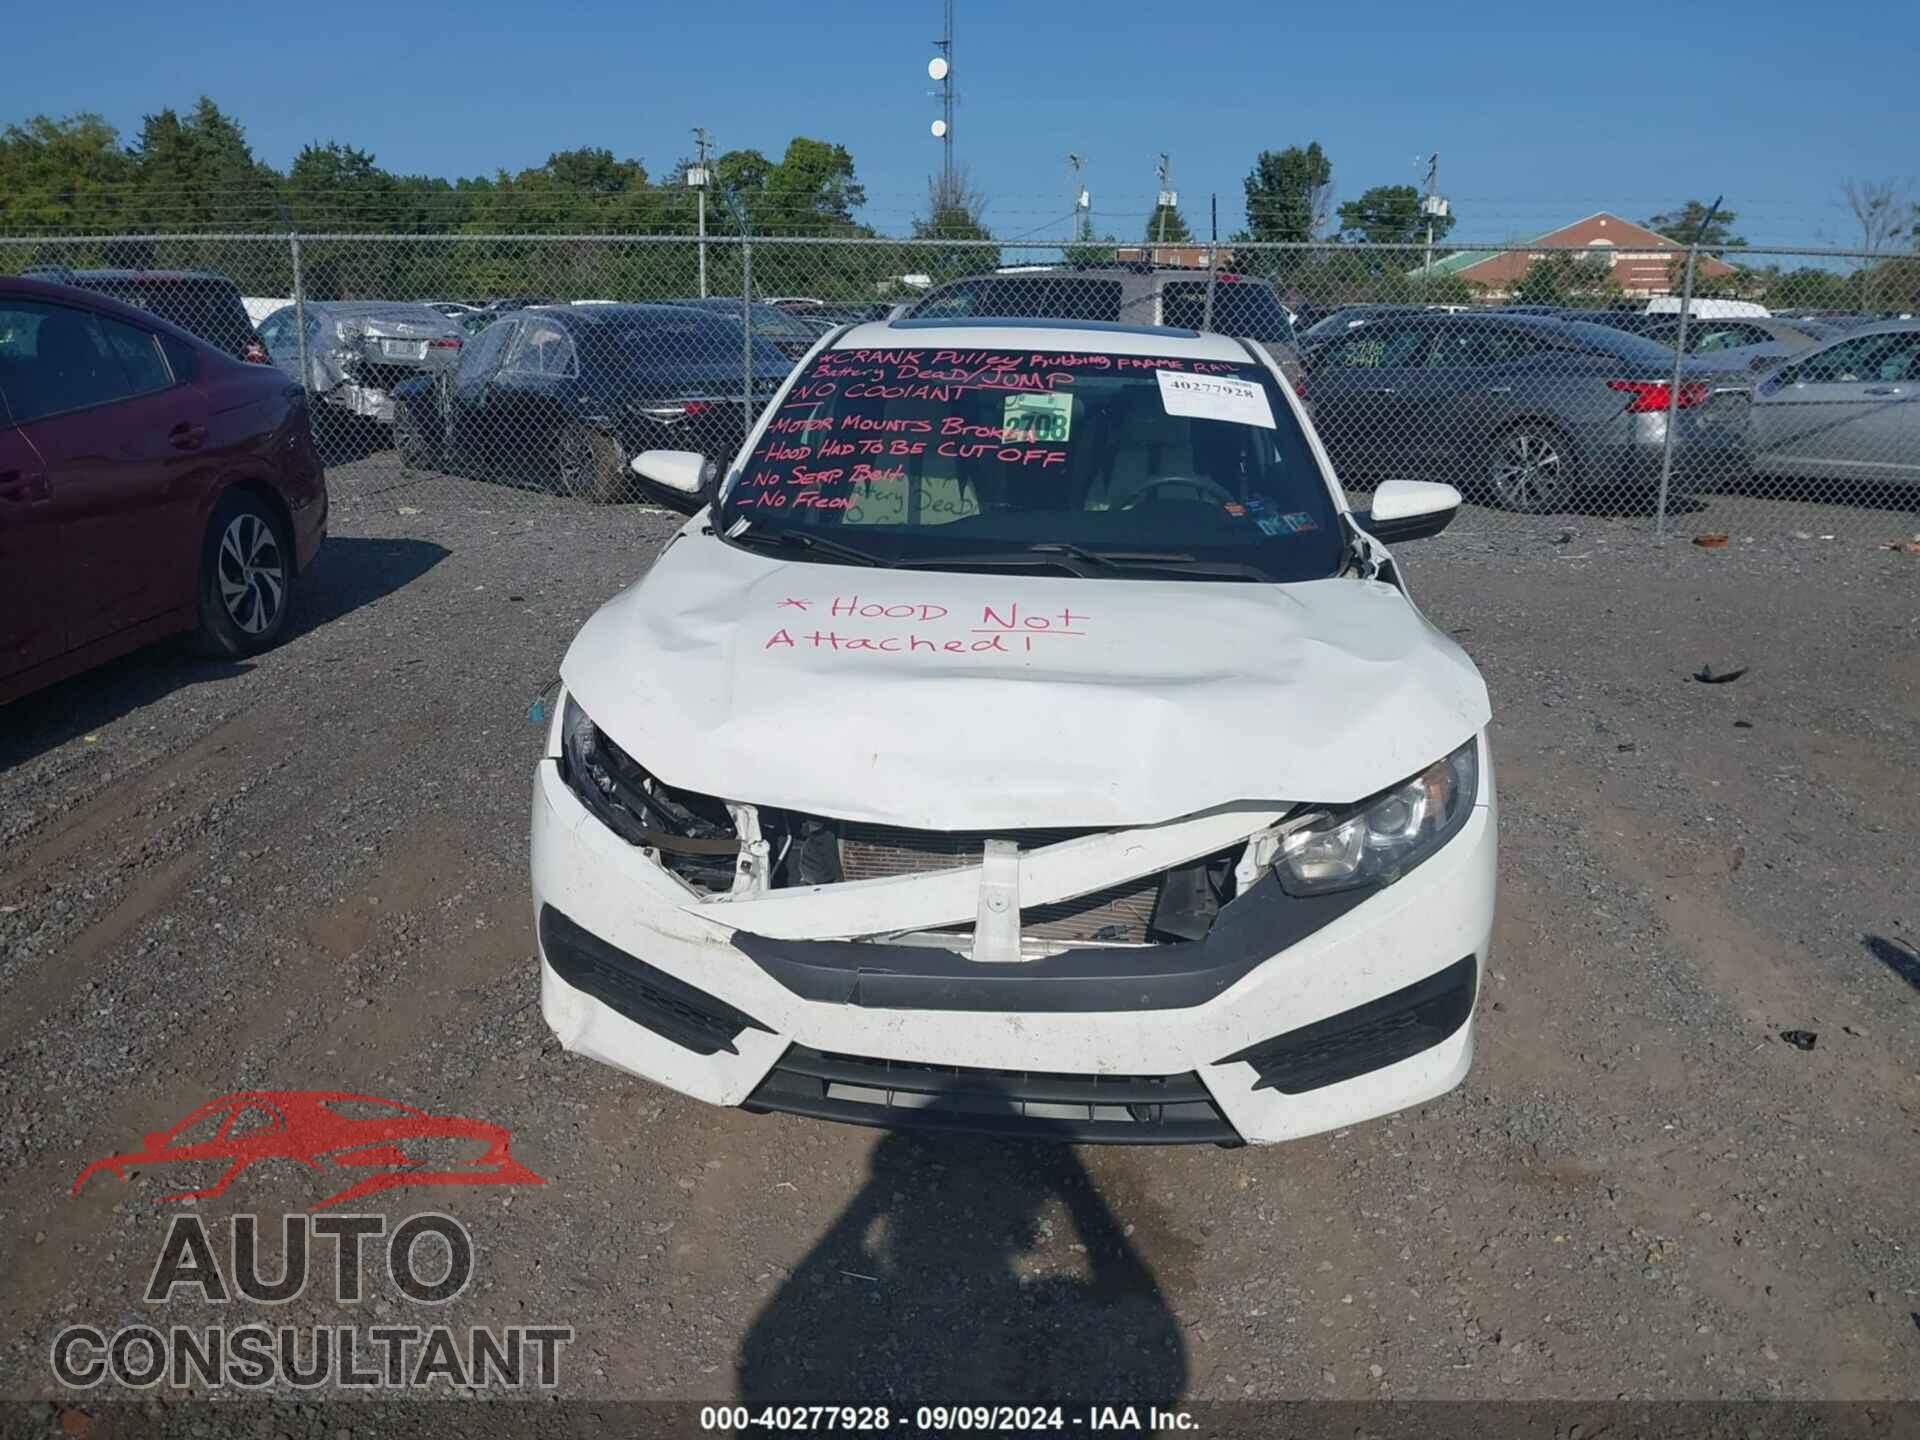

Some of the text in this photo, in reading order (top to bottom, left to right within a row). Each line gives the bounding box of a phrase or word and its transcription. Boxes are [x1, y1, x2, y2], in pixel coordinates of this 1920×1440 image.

[1118, 358, 1184, 370] FRAME
[1193, 362, 1240, 373] RAIL
[1171, 379, 1254, 398] 40277928
[858, 440, 883, 454] TO
[889, 440, 927, 455] BE
[937, 442, 999, 458] CUT
[997, 449, 1066, 467] OFF
[832, 596, 1091, 629] HOOD Not
